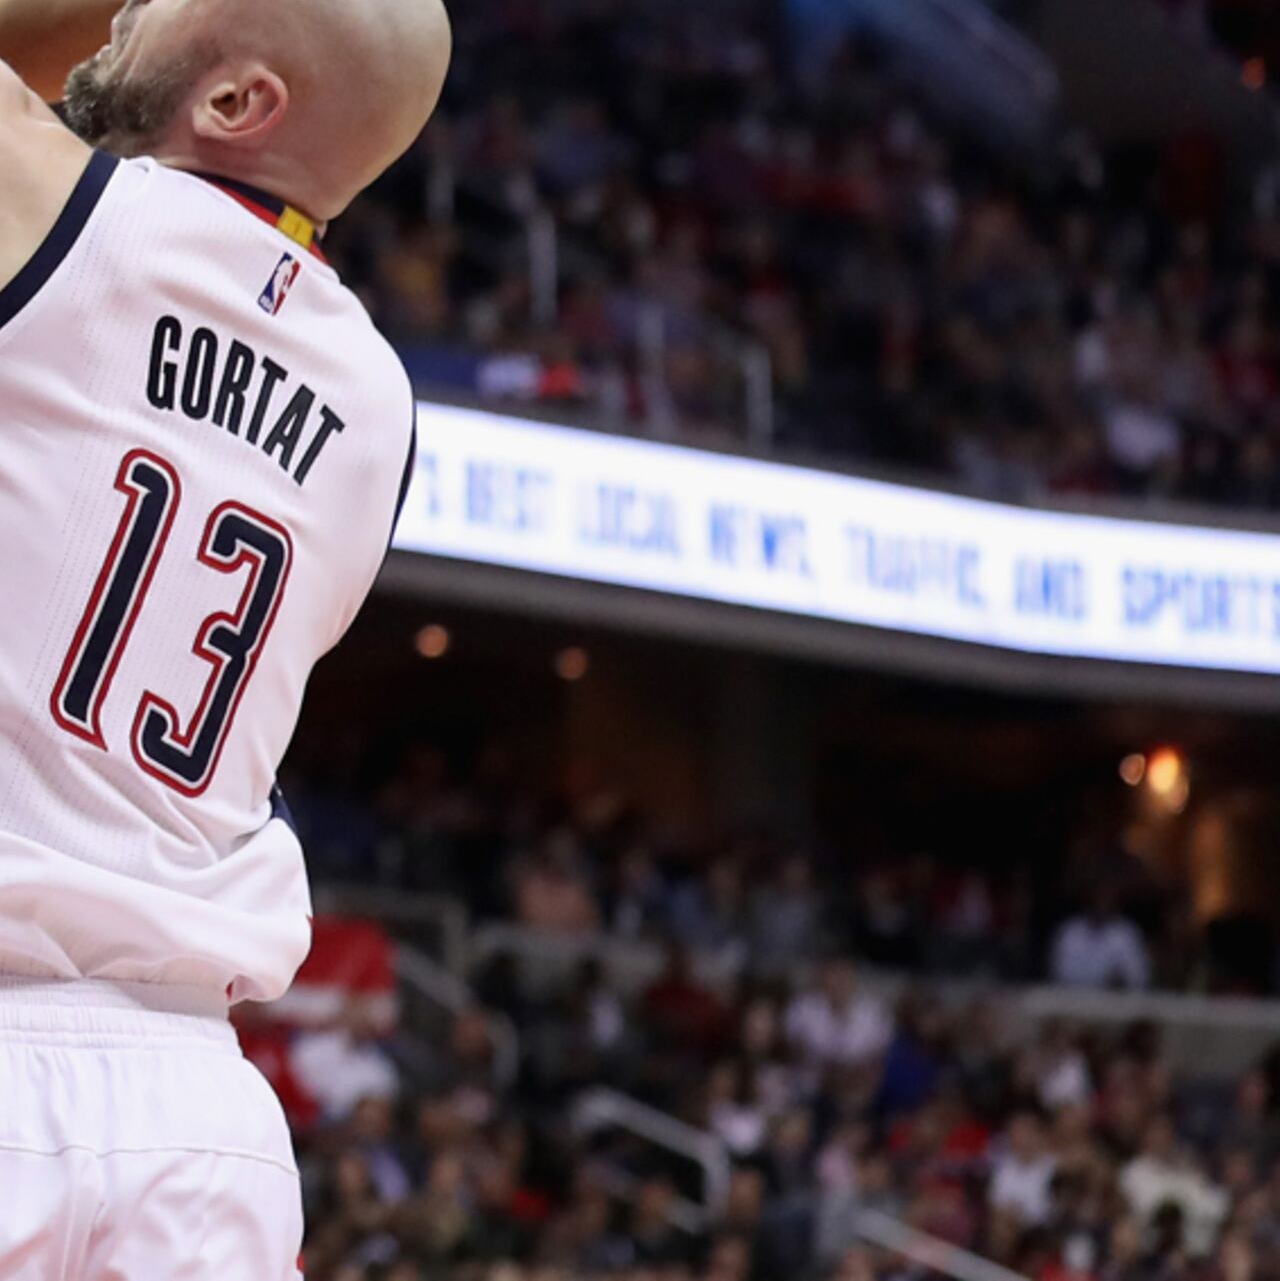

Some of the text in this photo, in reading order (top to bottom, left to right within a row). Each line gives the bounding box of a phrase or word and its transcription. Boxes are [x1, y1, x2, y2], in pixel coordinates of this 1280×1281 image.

[145, 314, 346, 487] GORTAT
[49, 447, 294, 799] 13
[1013, 557, 1089, 621] AND
